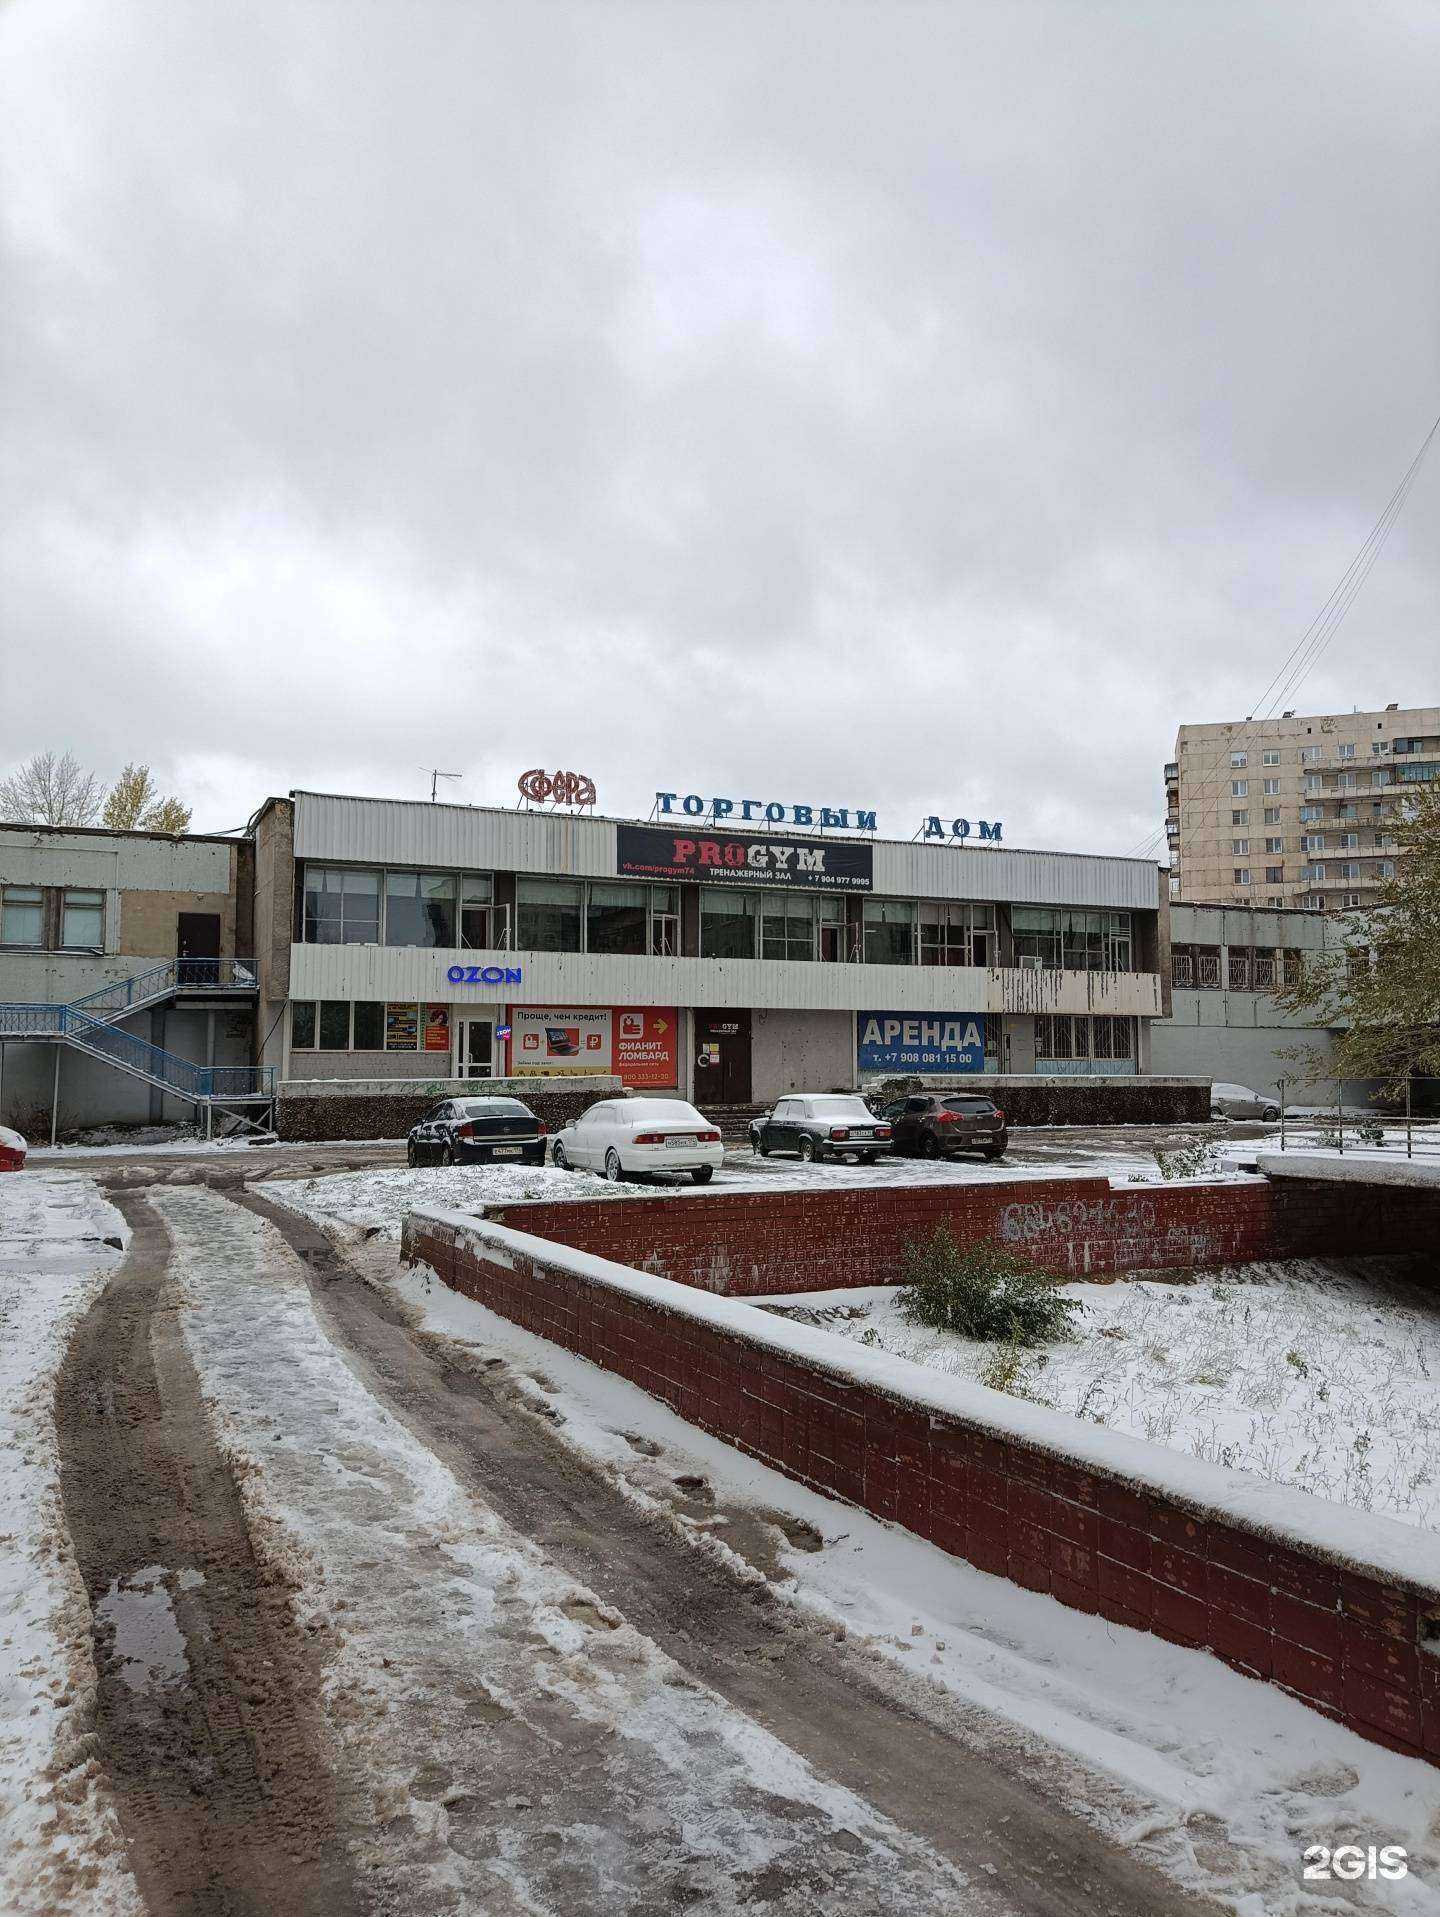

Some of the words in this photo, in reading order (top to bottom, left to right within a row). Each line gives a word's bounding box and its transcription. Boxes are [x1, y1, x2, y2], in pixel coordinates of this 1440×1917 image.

[925, 815, 1003, 842] ДОМ
[673, 839, 826, 871] PROGYM
[622, 862, 695, 875] vk.com/progym74
[709, 868, 773, 879] ТРЕНАЖЕРНЫЙ
[775, 871, 792, 880] ЗАЛ
[821, 875, 835, 883] 904
[836, 876, 850, 884] 977
[851, 877, 870, 885] 9995
[447, 965, 522, 984] OZON
[517, 1011, 552, 1021] Проще,
[573, 1013, 607, 1021] кредит!
[862, 1019, 982, 1051] АРЕНДА
[618, 1041, 662, 1050] ФИАНИТ
[618, 1051, 669, 1061] ЛОМБАРД
[873, 1054, 882, 1062] т.
[884, 1053, 897, 1062] +7
[900, 1053, 919, 1062] 908
[921, 1053, 941, 1063] 081
[944, 1054, 957, 1063] 15
[959, 1054, 972, 1063] 00
